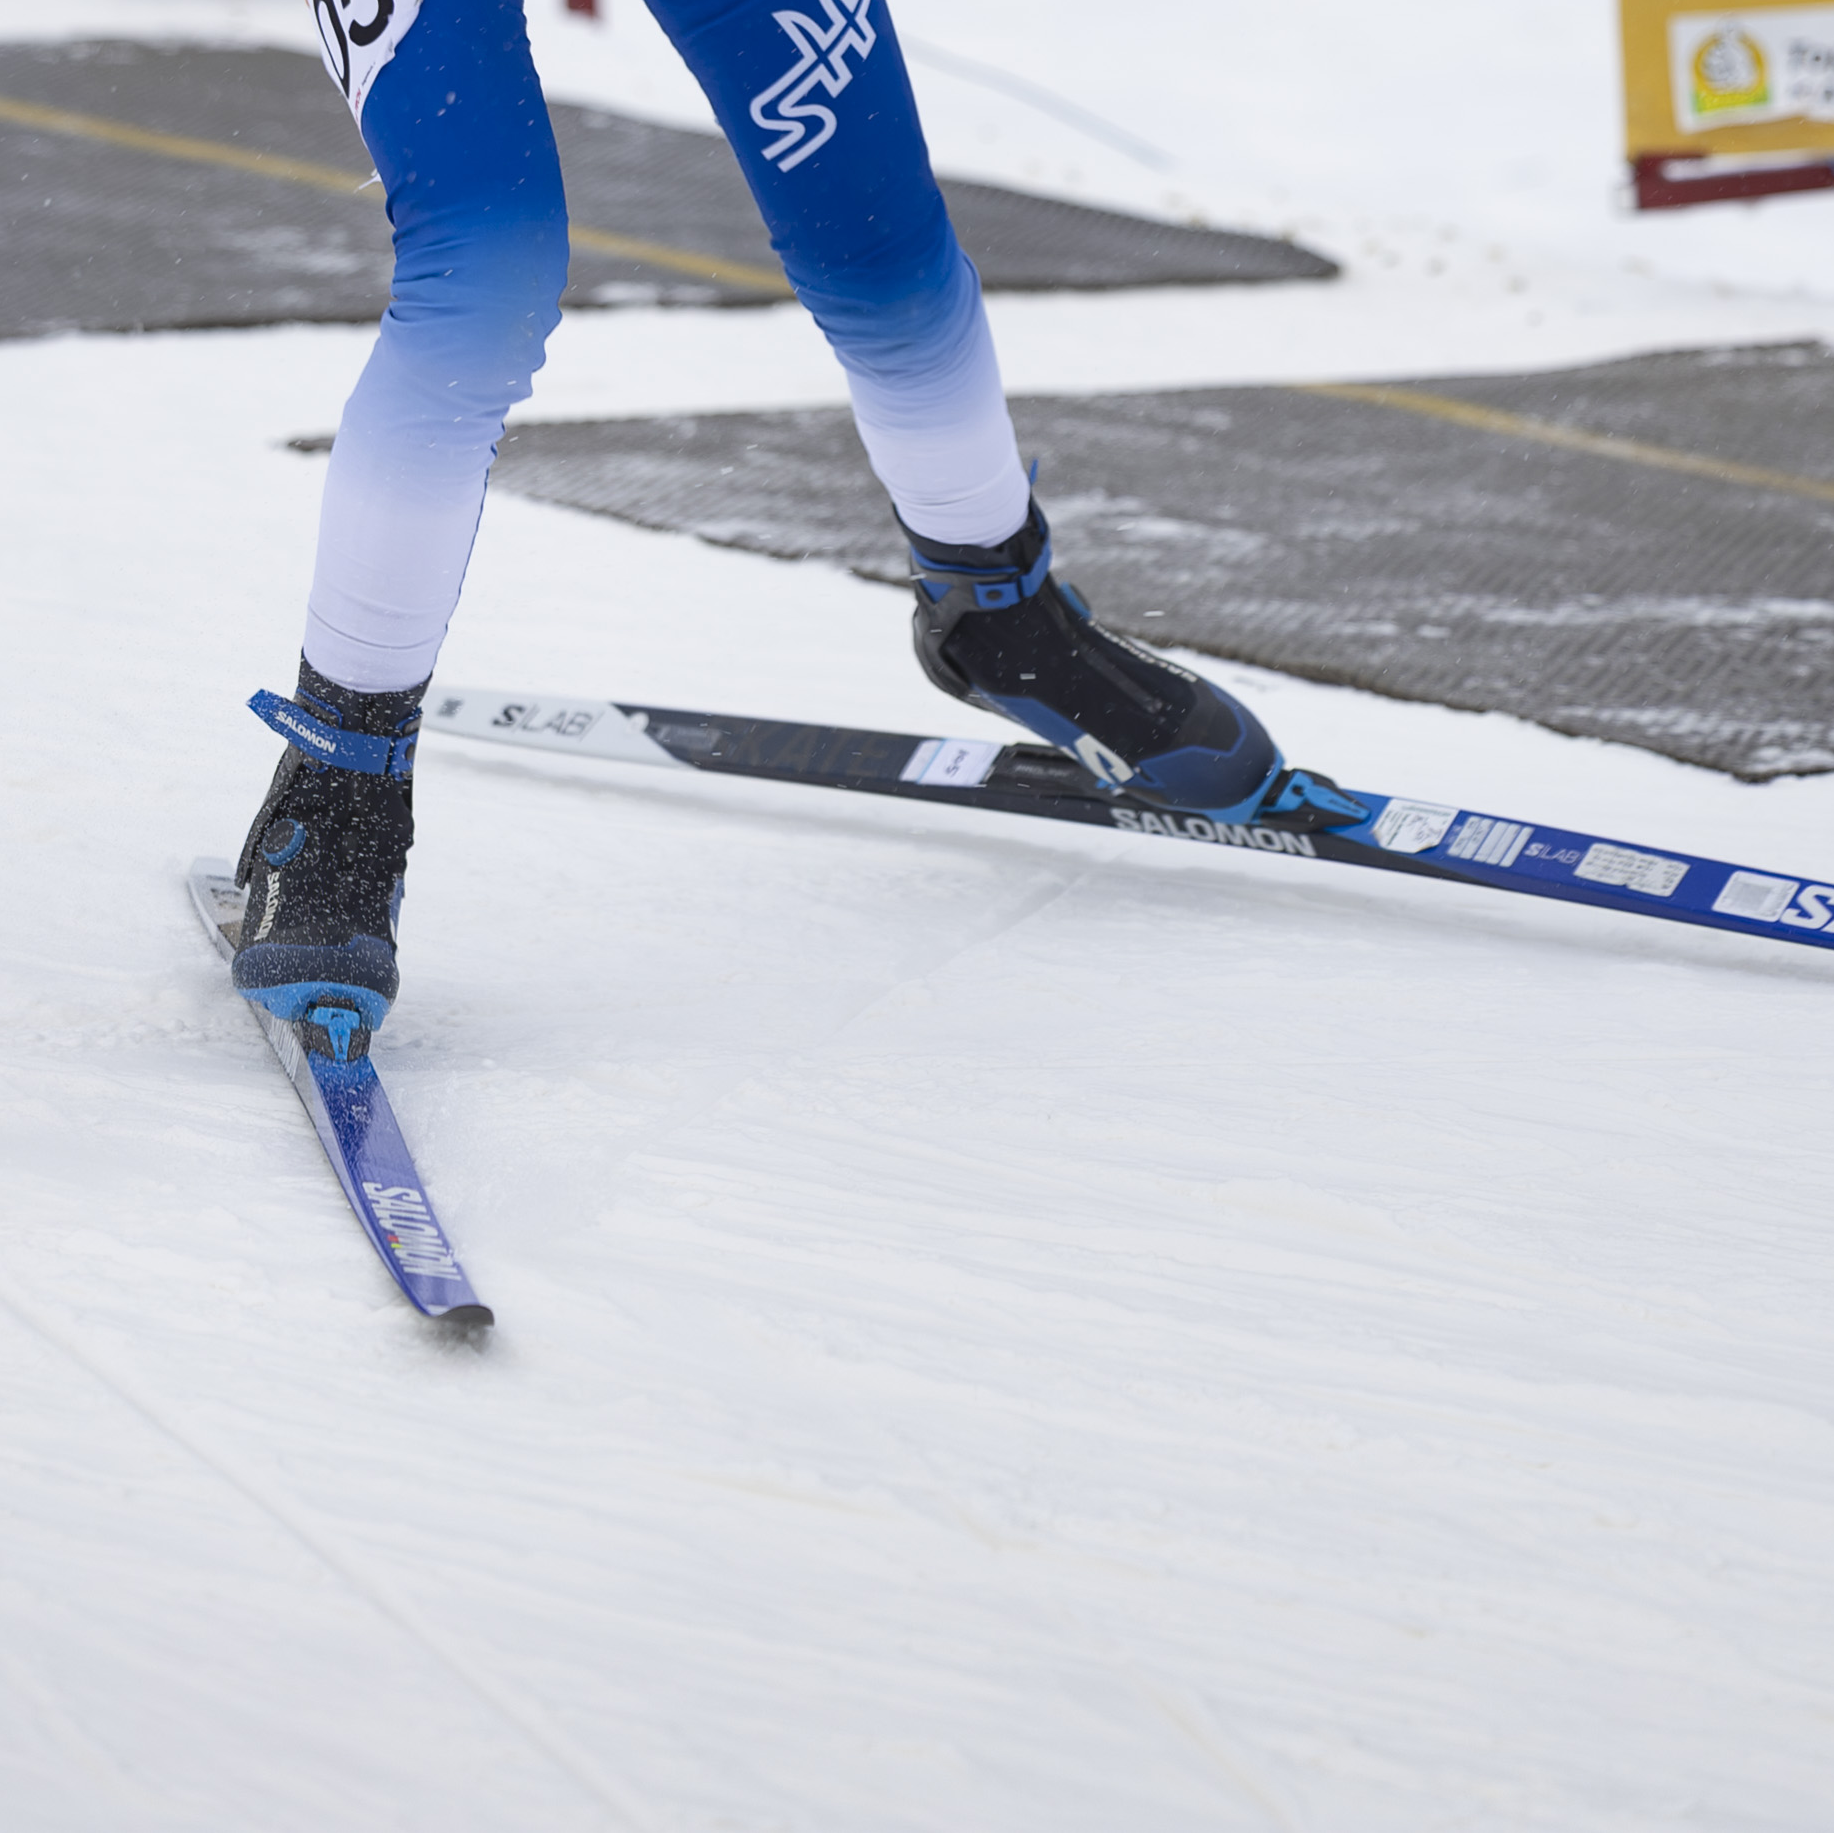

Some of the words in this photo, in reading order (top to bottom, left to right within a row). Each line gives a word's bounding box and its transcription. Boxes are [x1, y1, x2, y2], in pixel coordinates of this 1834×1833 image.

[275, 711, 337, 754] SALOMON
[1111, 807, 1317, 857] SALOMON
[362, 1182, 462, 1282] SALOMON
